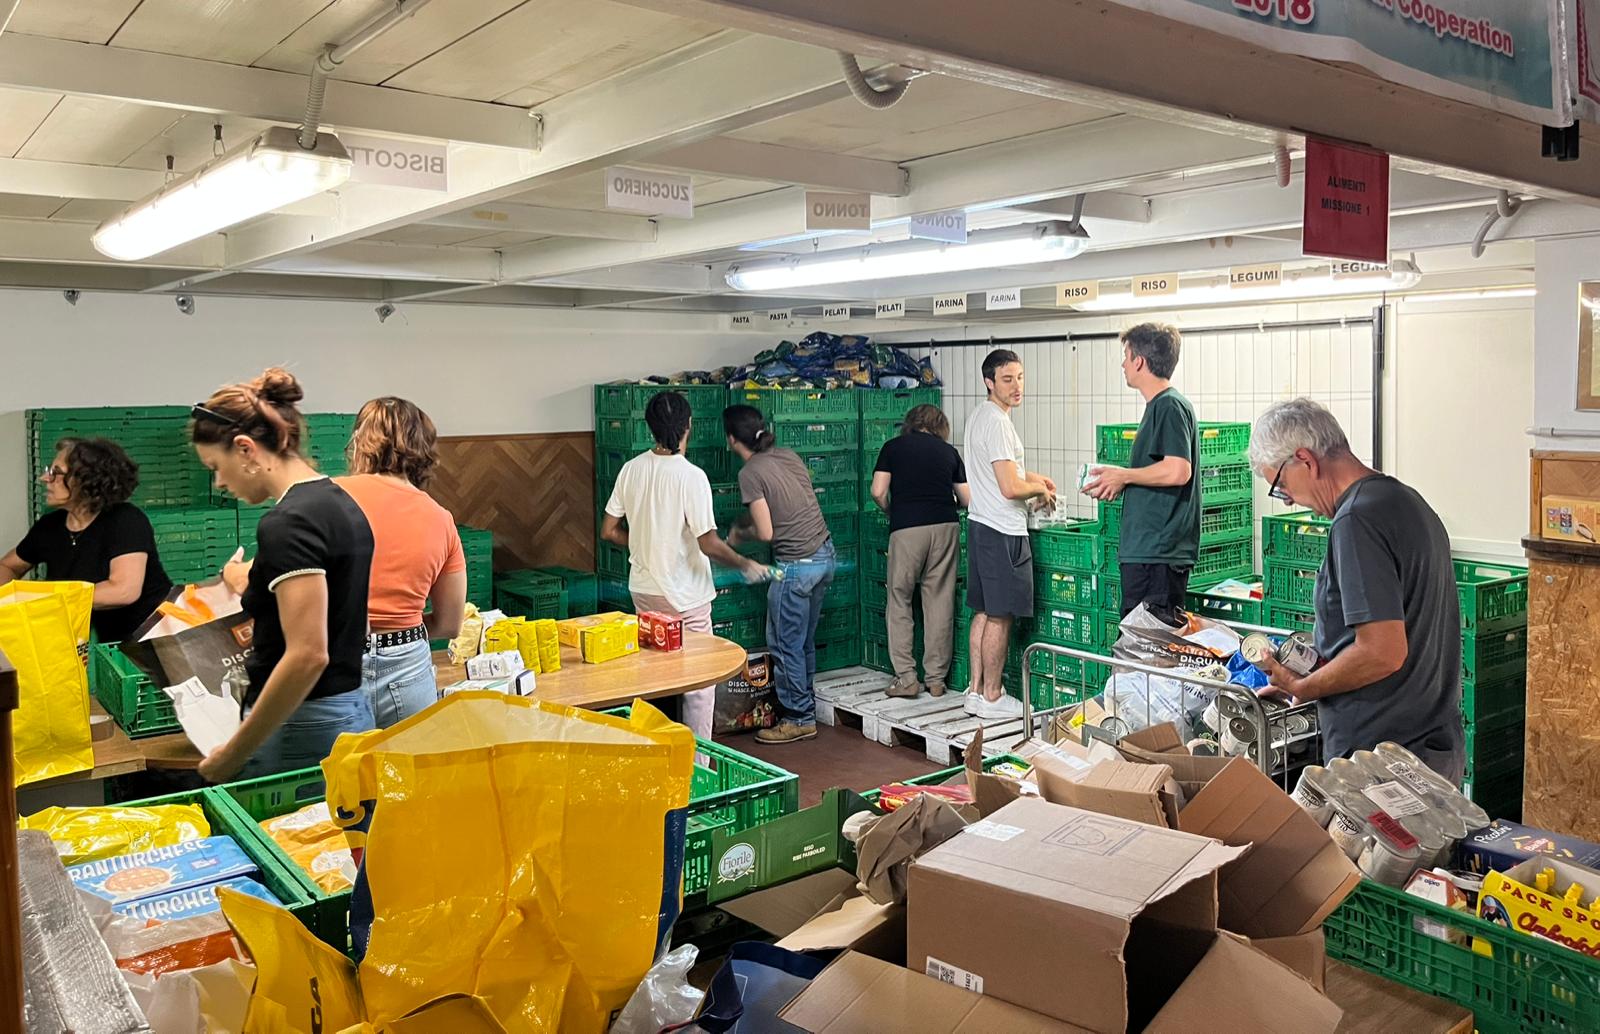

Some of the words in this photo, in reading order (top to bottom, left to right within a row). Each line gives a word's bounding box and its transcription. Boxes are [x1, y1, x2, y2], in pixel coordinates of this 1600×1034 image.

[1327, 176, 1366, 192] ALIMENTI
[1321, 198, 1362, 214] MISSIONE
[1366, 205, 1370, 216] 1
[1332, 262, 1391, 273] LEGU
[1230, 270, 1279, 283] LEGUMI
[1141, 280, 1167, 291] RISO
[990, 293, 1016, 303] FARINA
[1064, 287, 1088, 298] RISO
[877, 303, 902, 313] PELATI
[935, 298, 964, 309] FARINA
[769, 313, 788, 321] PASTA
[824, 308, 847, 317] PELATI
[732, 316, 750, 324] PASTA
[221, 645, 255, 667] DISC
[723, 850, 752, 871] Fiorile
[1502, 881, 1553, 911] PACK
